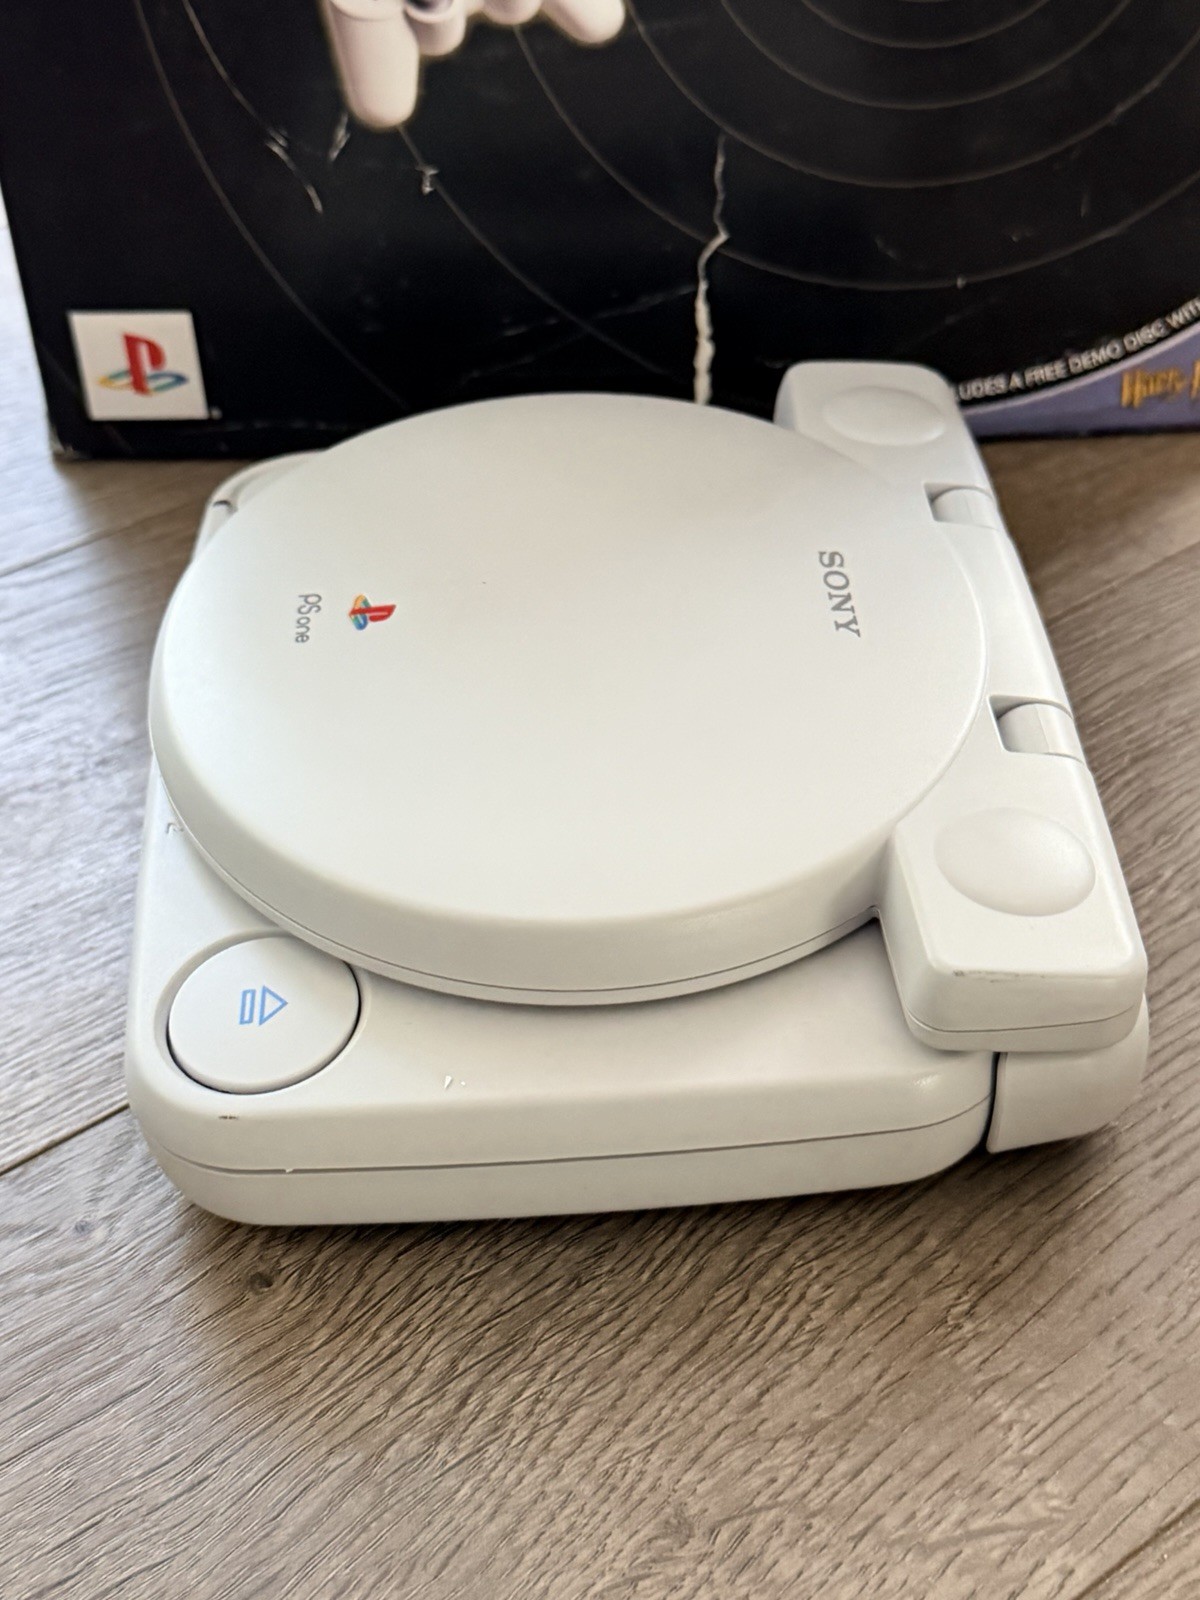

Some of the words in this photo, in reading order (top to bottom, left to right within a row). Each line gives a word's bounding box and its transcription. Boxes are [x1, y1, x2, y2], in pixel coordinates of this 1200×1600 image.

[956, 373, 1009, 400] UDES
[1009, 371, 1025, 391] A
[1024, 360, 1068, 387] FREE
[1068, 340, 1125, 374] DEMO
[1123, 318, 1171, 352] DISC
[818, 551, 861, 638] SONY
